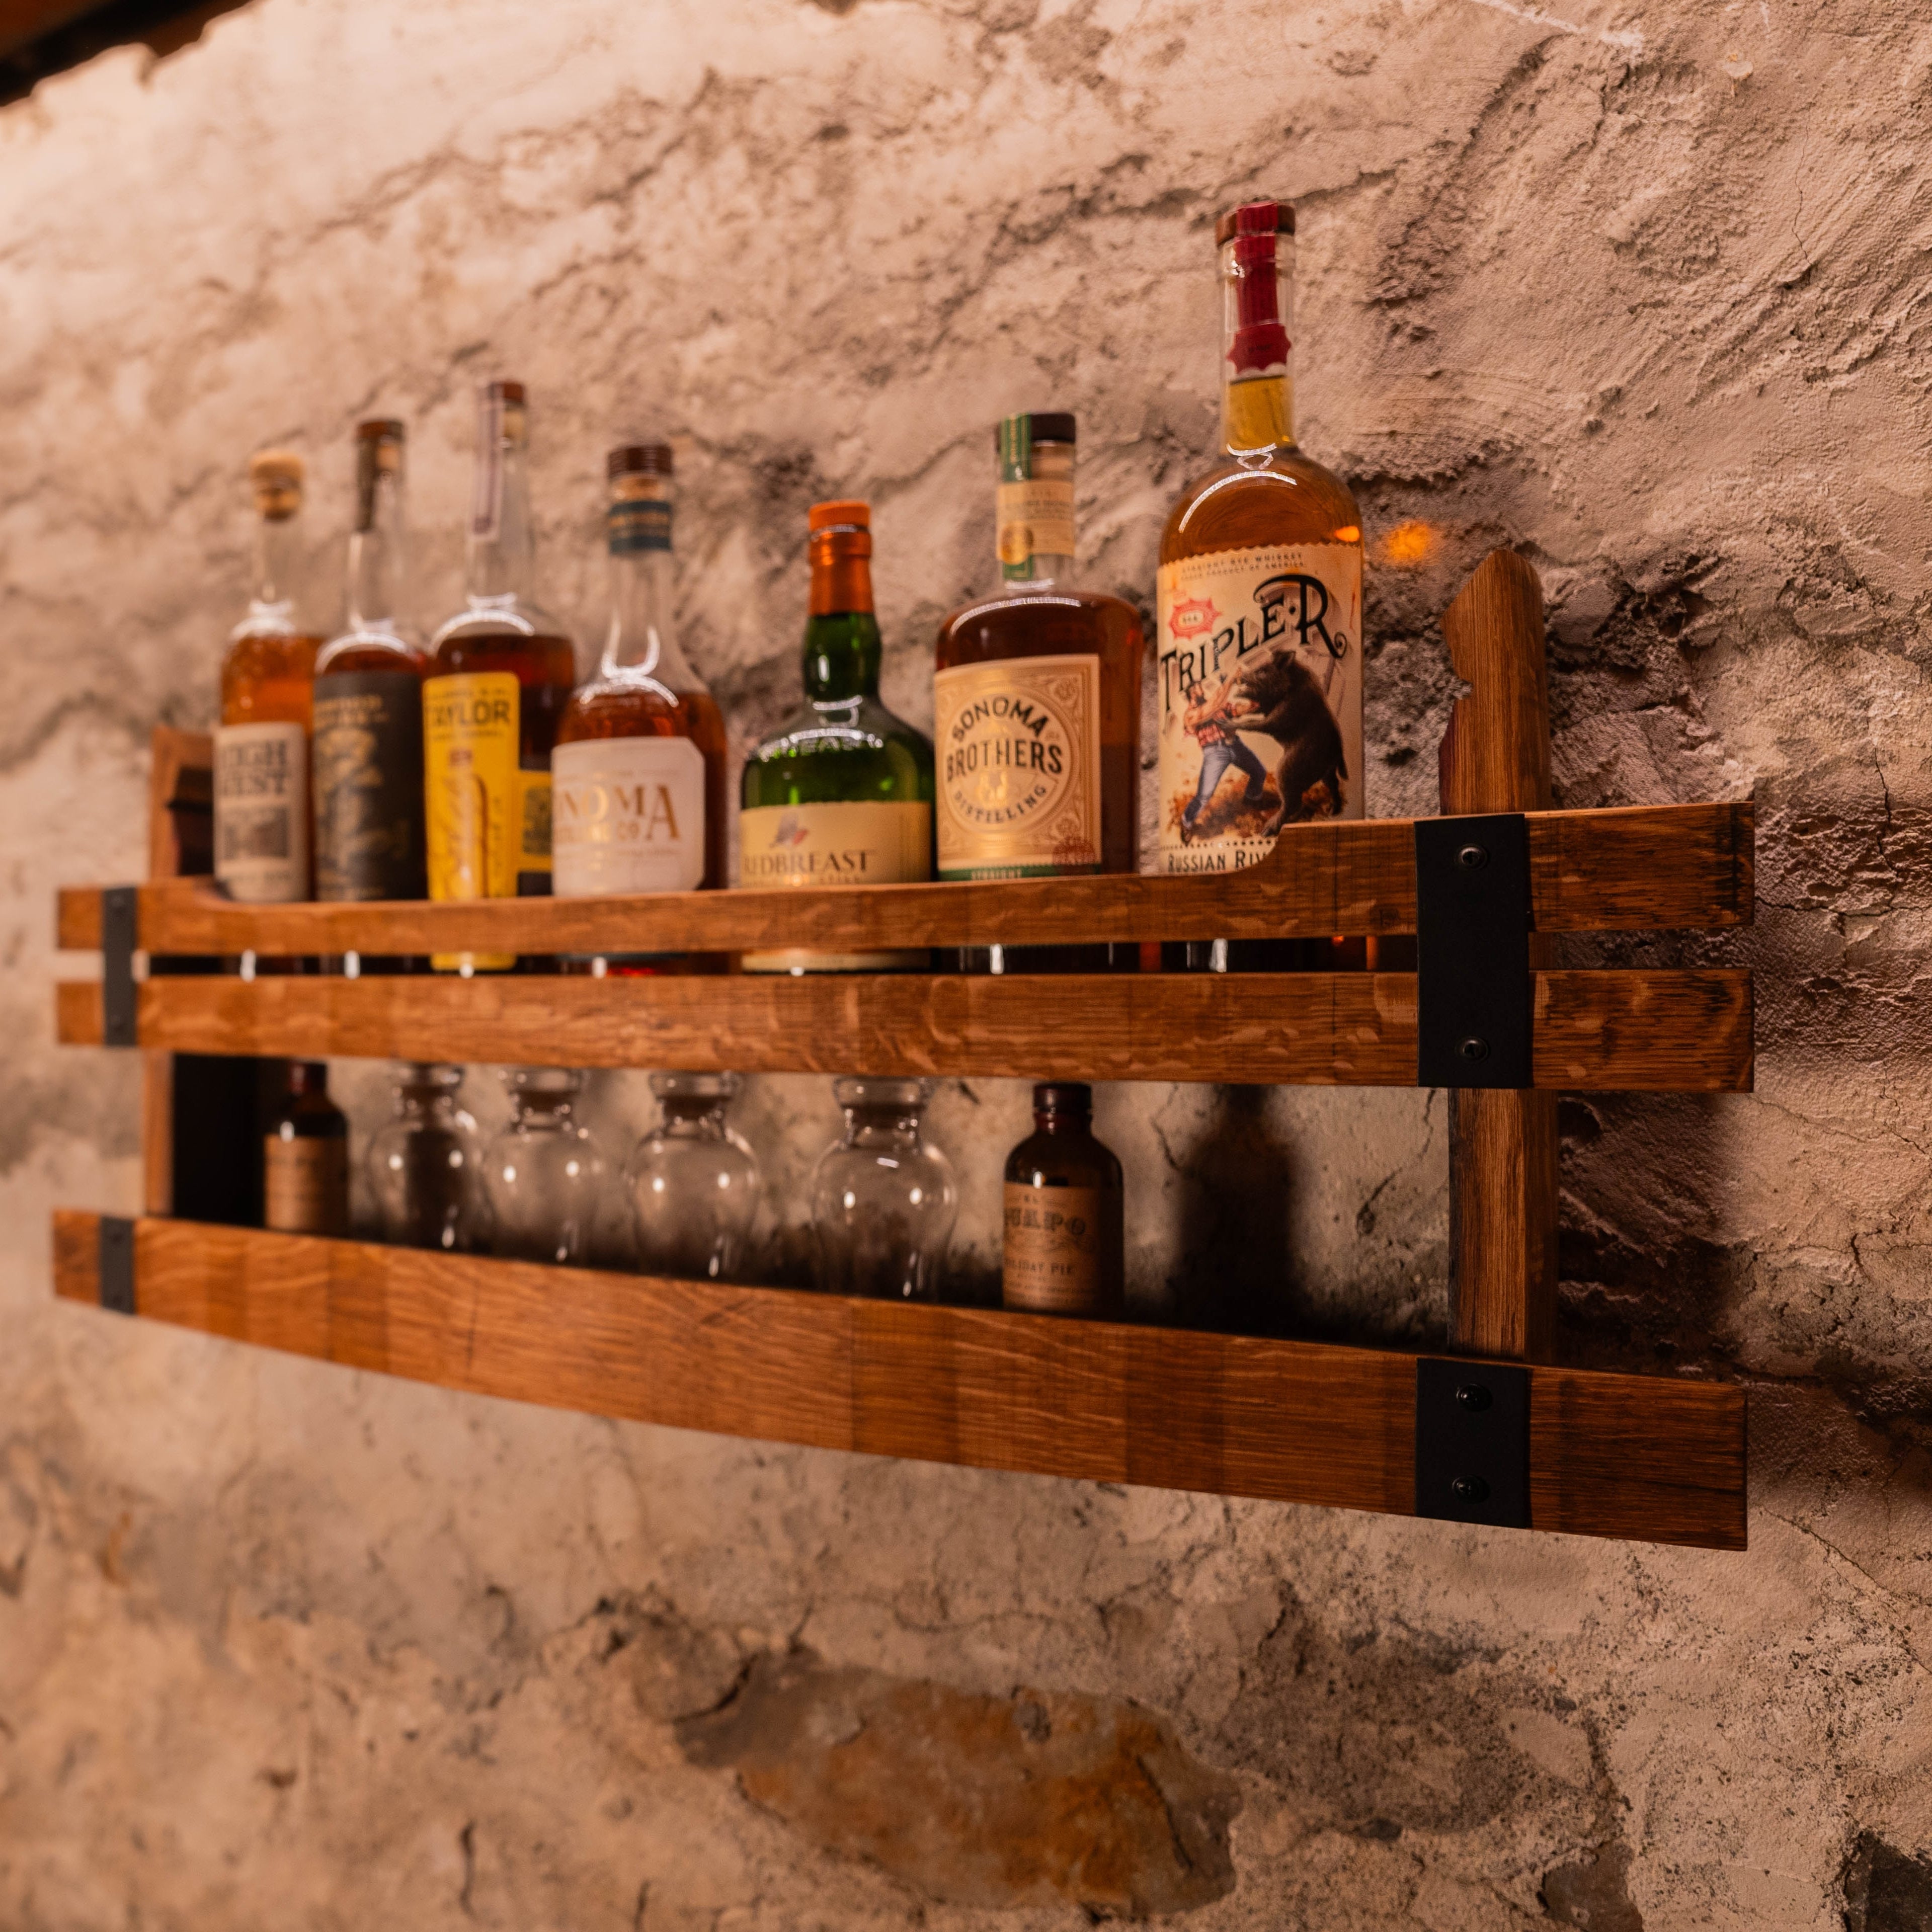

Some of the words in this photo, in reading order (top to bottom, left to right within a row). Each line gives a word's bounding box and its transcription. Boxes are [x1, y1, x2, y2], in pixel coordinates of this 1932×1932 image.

[952, 696, 1050, 741] SONOMA
[945, 738, 1063, 784] BROTHERS
[953, 785, 1047, 824] DISTILLING
[1167, 854, 1226, 872] RUSSIAN
[1234, 850, 1267, 869] RIV
